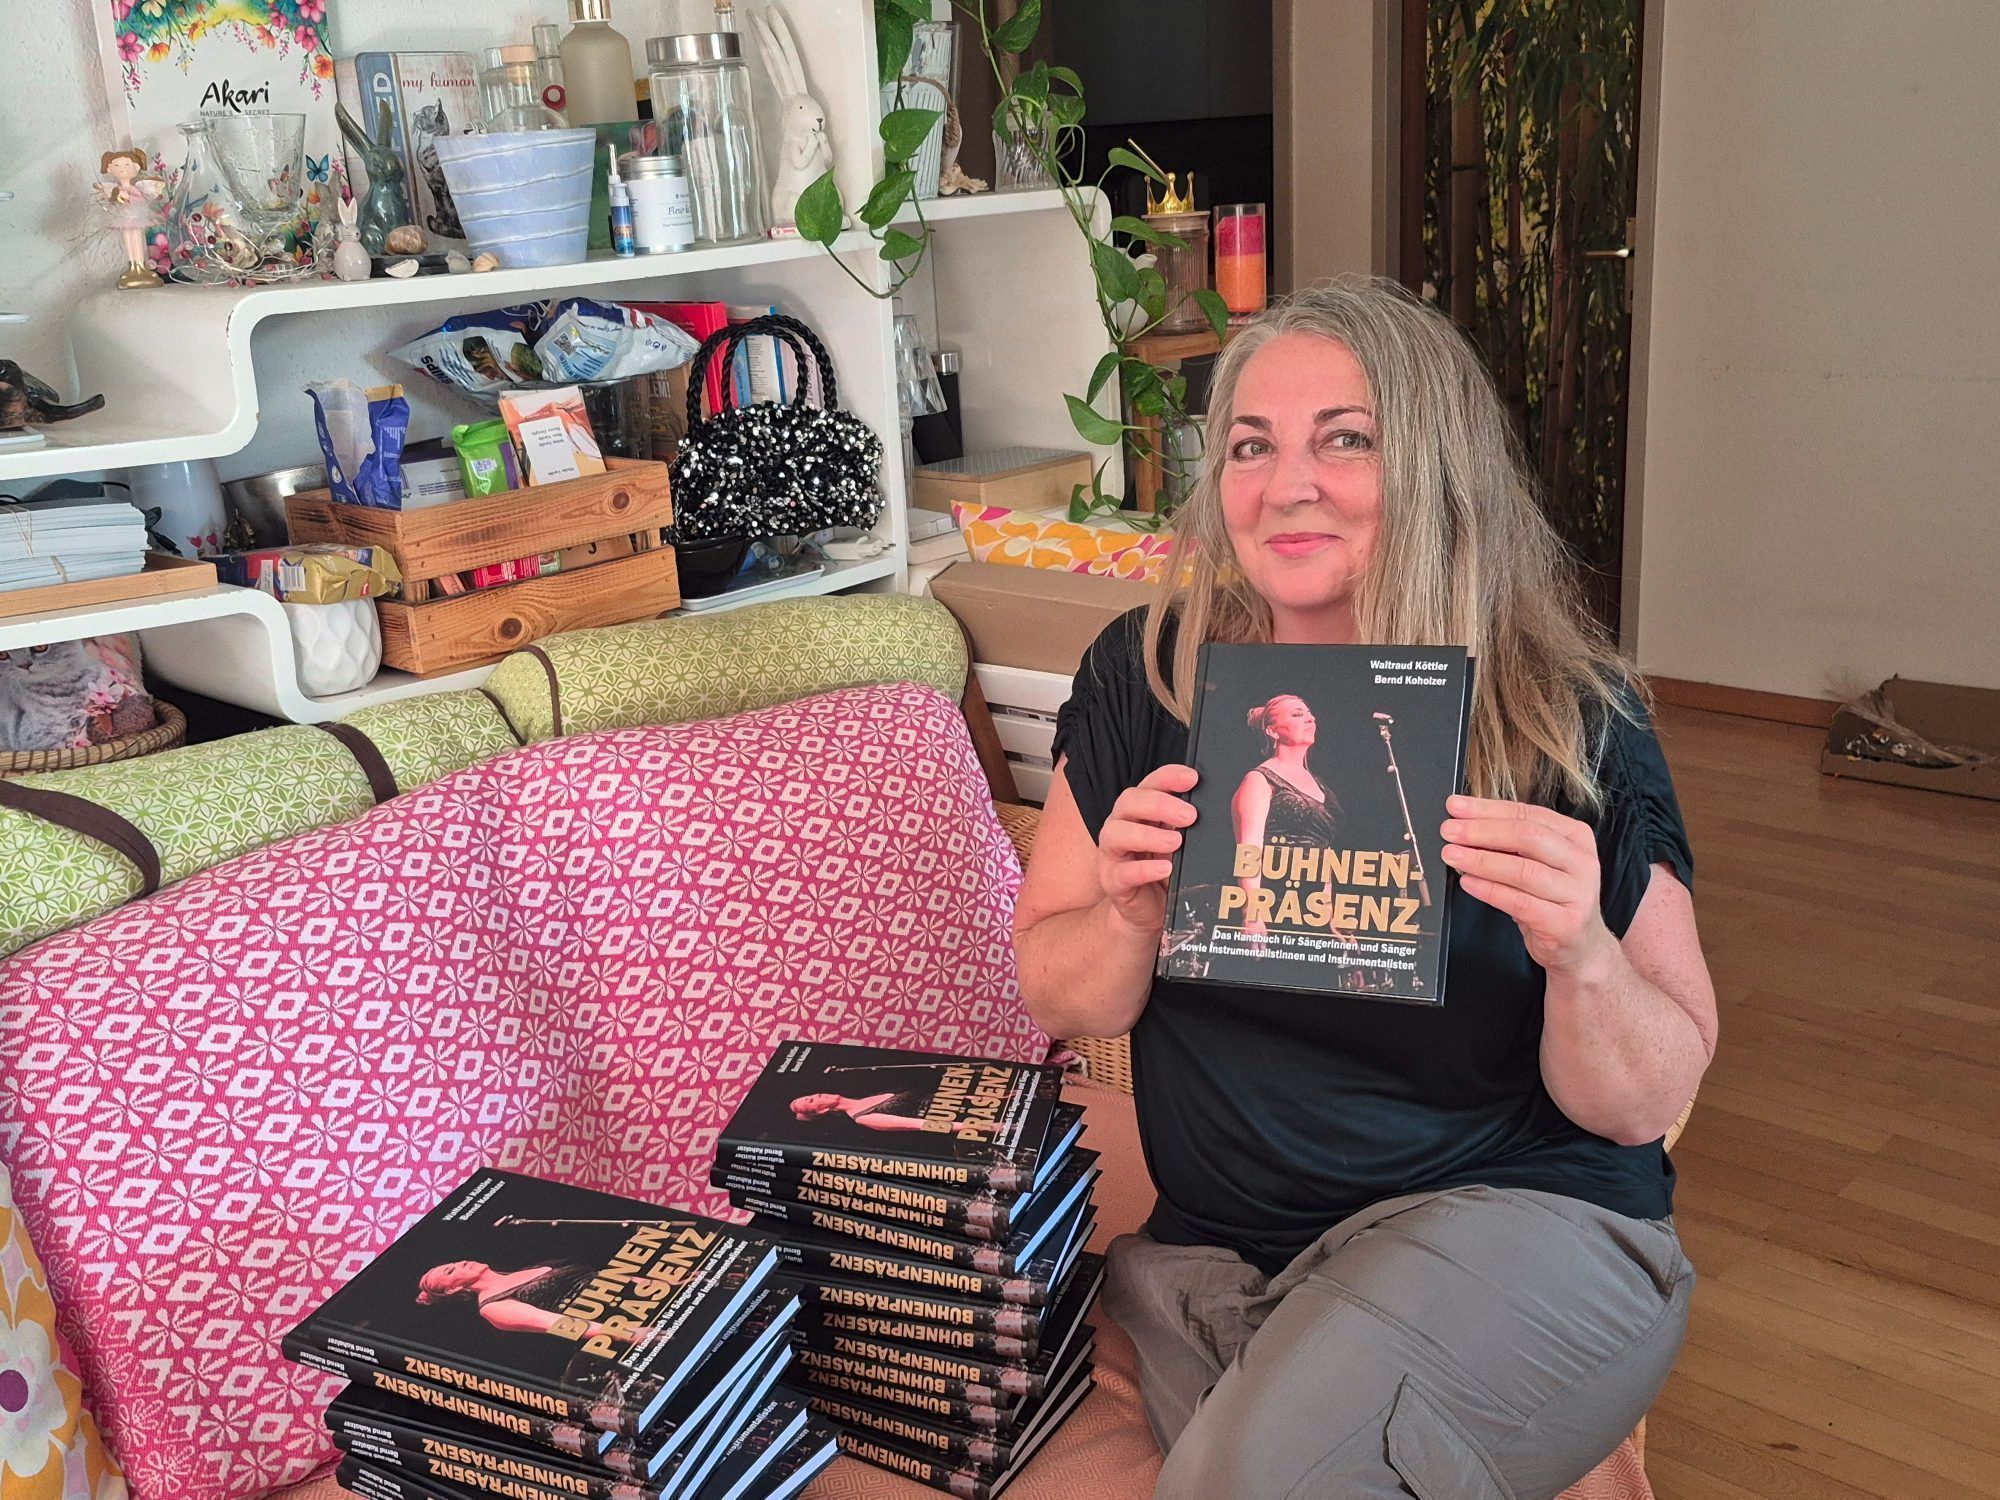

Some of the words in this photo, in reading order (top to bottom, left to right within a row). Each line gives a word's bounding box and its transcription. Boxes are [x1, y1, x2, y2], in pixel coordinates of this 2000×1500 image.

[200, 79, 269, 113] Akari
[402, 79, 424, 93] my
[430, 71, 476, 88] human
[1369, 660, 1413, 670] Waltraud
[1414, 660, 1449, 671] Köttler
[1374, 674, 1404, 685] Bernd
[1404, 675, 1447, 686] Koholzer
[1233, 835, 1424, 889] BÜHNEN-
[1217, 880, 1420, 934] PRÄSENZ
[1181, 943, 1207, 953] sowie
[1209, 942, 1305, 960] Instrumentalistinnen
[1307, 953, 1326, 962] und
[1328, 953, 1415, 970] Instrumentalisten
[1213, 929, 1232, 941] Das
[1233, 931, 1280, 944] Handbuch
[1282, 935, 1296, 946] für
[1297, 936, 1358, 950] Sängerinnen
[1360, 943, 1379, 953] und
[1380, 944, 1416, 957] Sänger
[918, 1063, 975, 1134] BÜHNEN-
[956, 1065, 1013, 1142] PRÄSENZ
[812, 1151, 968, 1184] BÜHNENPRÄSENZ
[441, 1195, 474, 1221] Waltraud
[468, 1177, 493, 1197] Köttler
[458, 1203, 482, 1221] Bernd
[477, 1180, 506, 1204] Koholzer
[801, 1168, 947, 1214] BÜHNENPRÄSENZ
[713, 1237, 735, 1260] Sänger
[812, 1211, 954, 1261] BÜHNENPRÄSENZ
[546, 1221, 672, 1341] BÜHNEN-
[704, 1258, 718, 1272] und
[829, 1252, 982, 1293] BÜHNENPRÄSENZ
[581, 1227, 717, 1359] PRÄSENZ
[670, 1270, 707, 1310] Sängerinnen
[819, 1286, 974, 1325] BÜHNENPRÄSENZ
[619, 1371, 640, 1393] sowie
[637, 1305, 696, 1373] Instrumentalistinnen
[691, 1291, 707, 1306] und
[700, 1240, 749, 1294] Instrumentalisten
[665, 1308, 676, 1320] für
[822, 1312, 975, 1348] BÜHNENPRÄSENZ
[638, 1318, 667, 1353] Handbuch
[622, 1352, 640, 1368] Das
[800, 1350, 946, 1394] BÜHNENPRÄSENZ
[373, 1371, 532, 1436] BÜHNENPRÄSENZ
[404, 1356, 569, 1417] BÜHNENPRÄSENZ
[808, 1369, 951, 1415] BÜHNENPRÄSENZ
[810, 1396, 949, 1450] BÜHNENPRÄSENZ
[421, 1438, 589, 1495] BÜHNENPRÄSENZ
